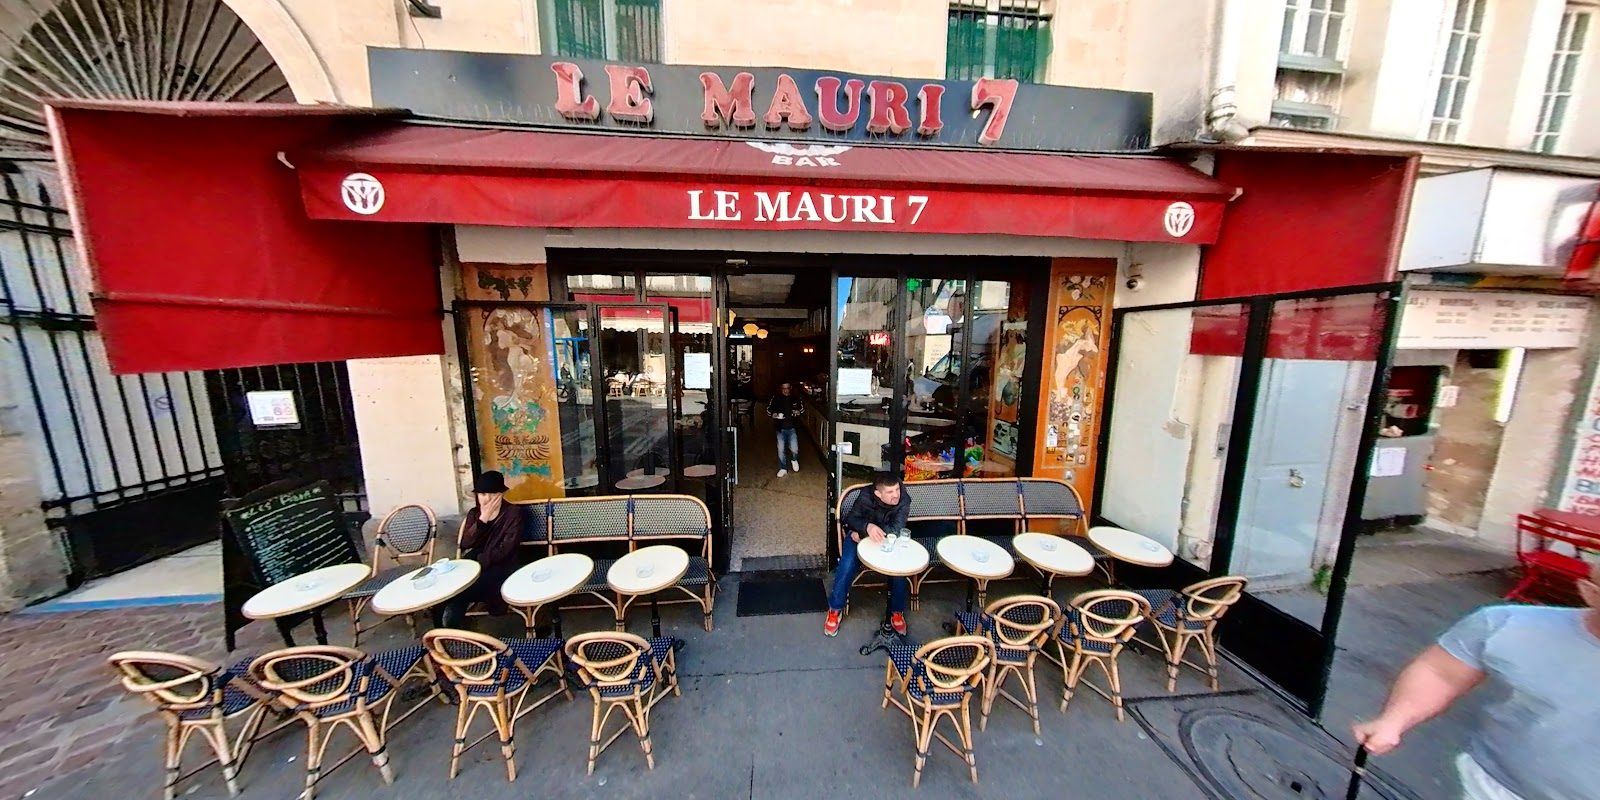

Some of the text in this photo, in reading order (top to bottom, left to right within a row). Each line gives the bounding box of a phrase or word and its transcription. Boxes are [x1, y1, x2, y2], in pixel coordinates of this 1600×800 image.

[551, 61, 1019, 145] LE MAURI 7
[771, 154, 841, 167] BAR
[687, 190, 929, 225] LE MAURI 7
